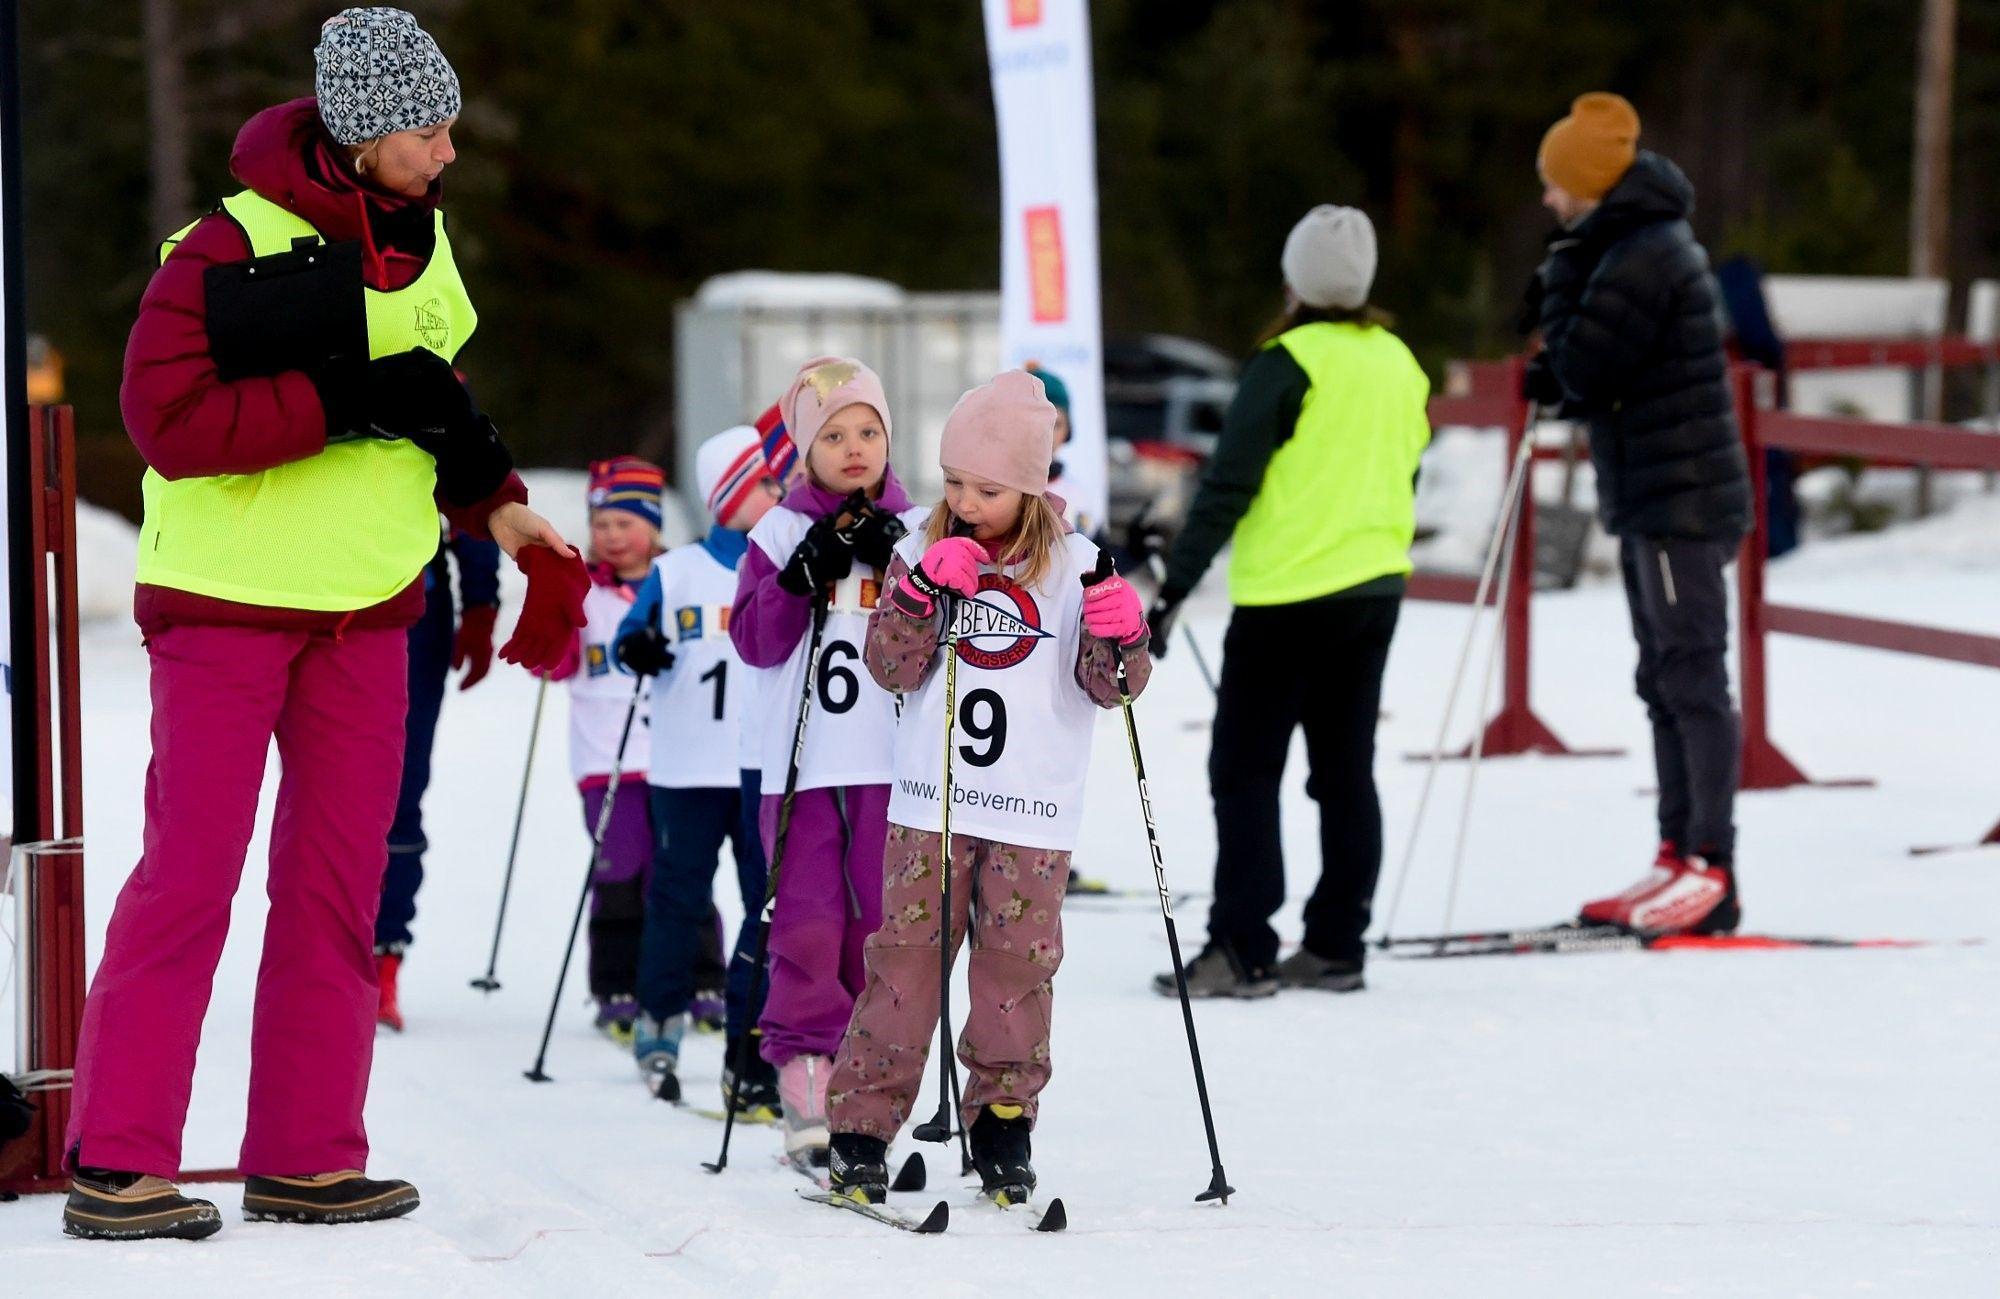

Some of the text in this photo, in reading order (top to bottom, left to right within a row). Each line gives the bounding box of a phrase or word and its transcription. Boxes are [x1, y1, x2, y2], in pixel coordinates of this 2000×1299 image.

[700, 660, 727, 720] 1
[817, 640, 859, 714] 6
[946, 646, 954, 715] FISCHER
[958, 688, 1008, 767] 9
[899, 779, 1058, 818] www.bevern.no
